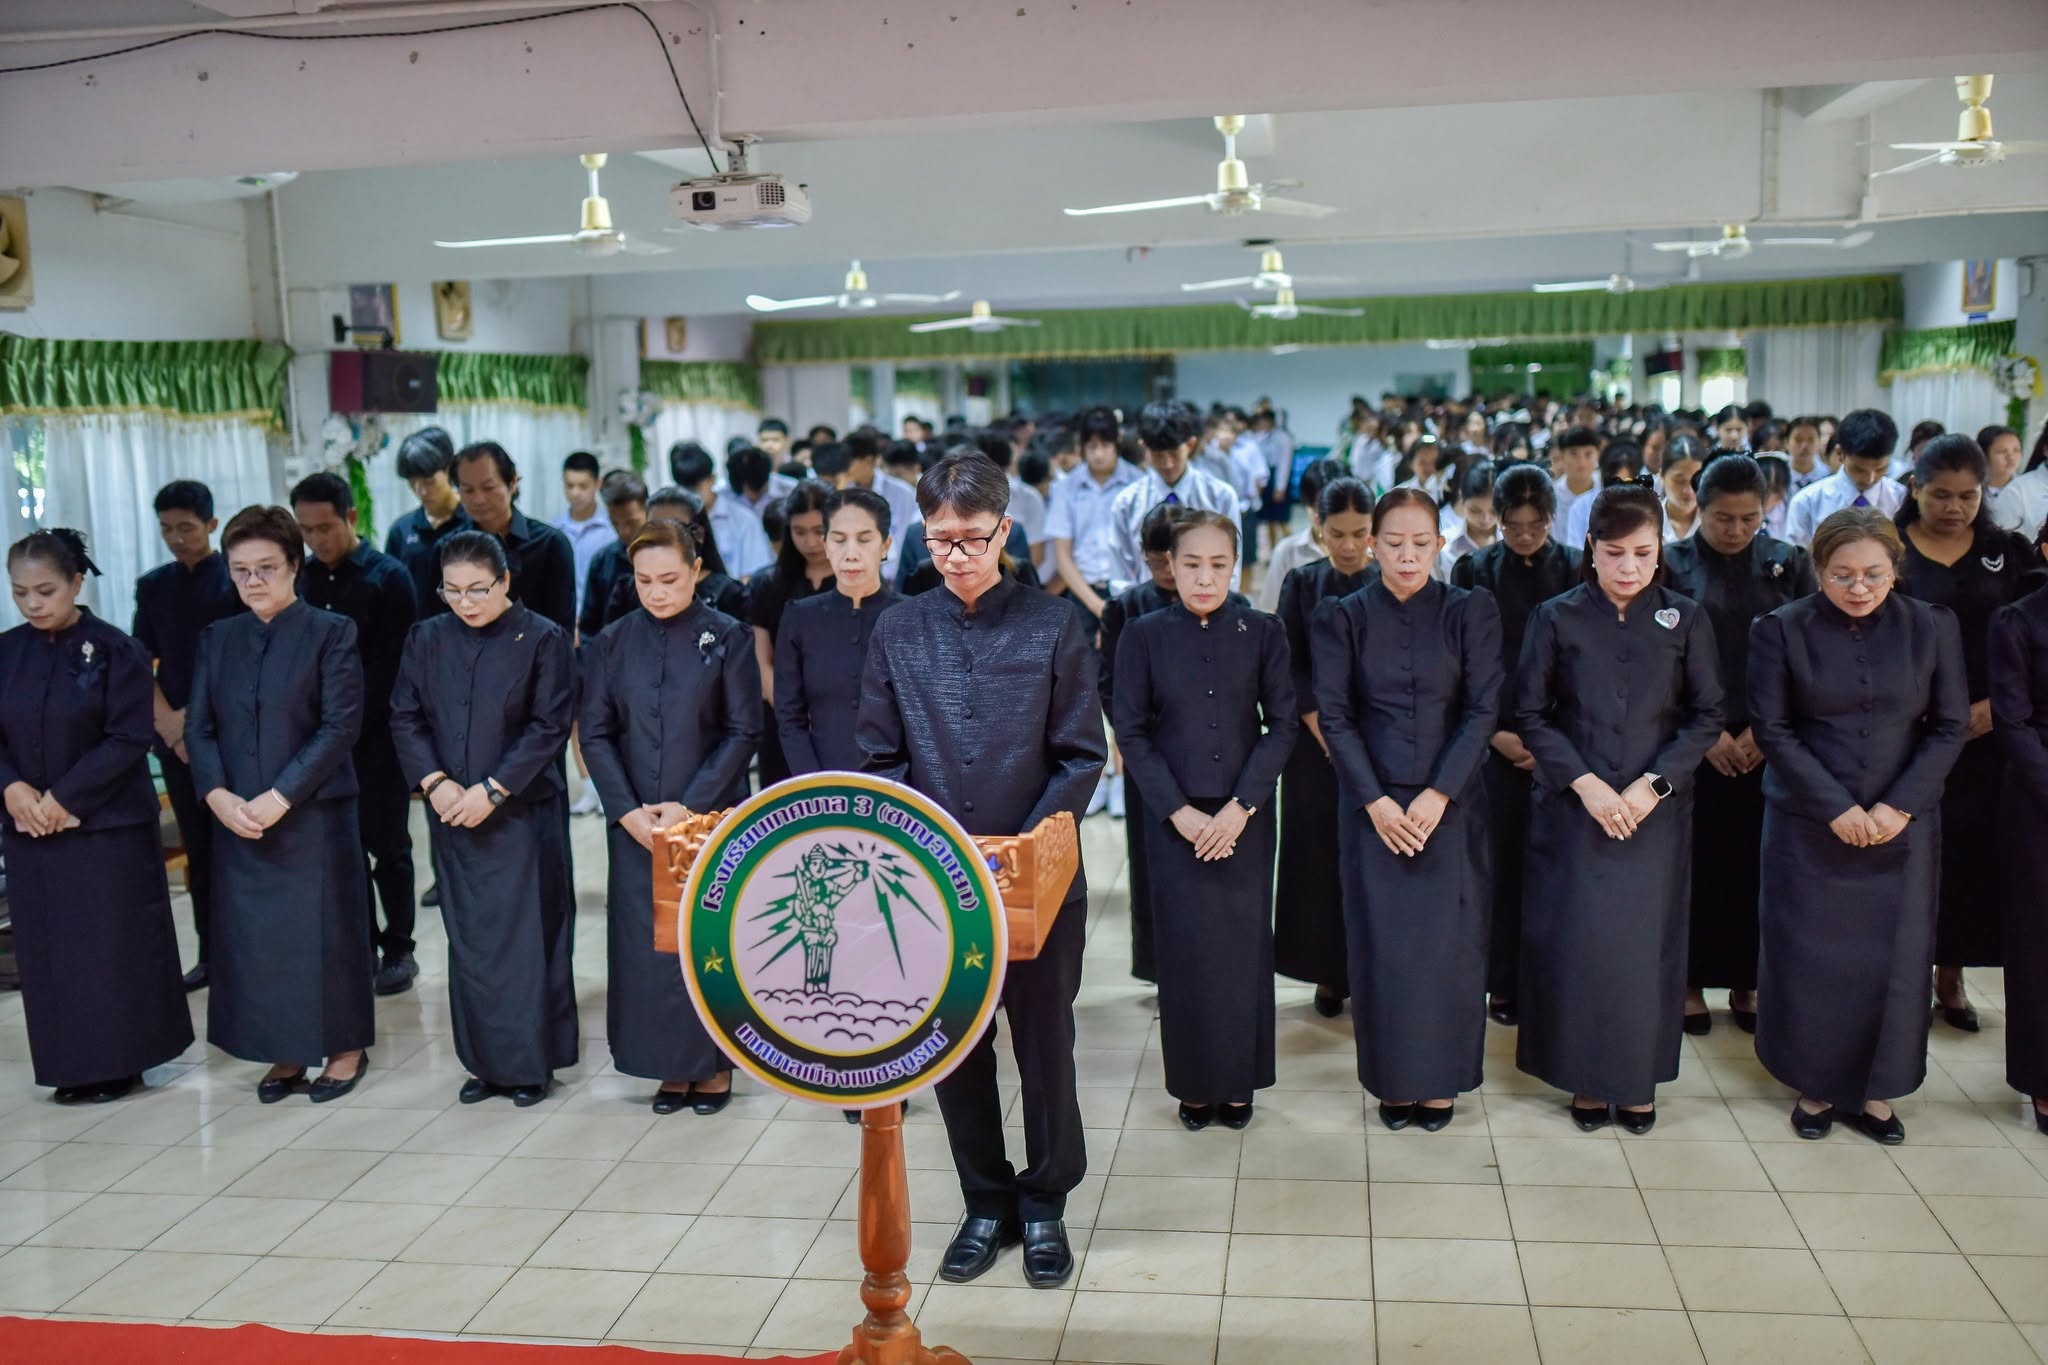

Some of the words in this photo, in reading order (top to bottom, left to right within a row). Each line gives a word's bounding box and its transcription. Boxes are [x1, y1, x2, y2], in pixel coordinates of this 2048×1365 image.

[702, 796, 848, 912] โรงเรียนเทศบาล
[854, 795, 873, 816] 3
[877, 802, 979, 911] (ชาญวิทยา)
[735, 1018, 949, 1089] เทศบาลเมืองเพชรบูรณ์
